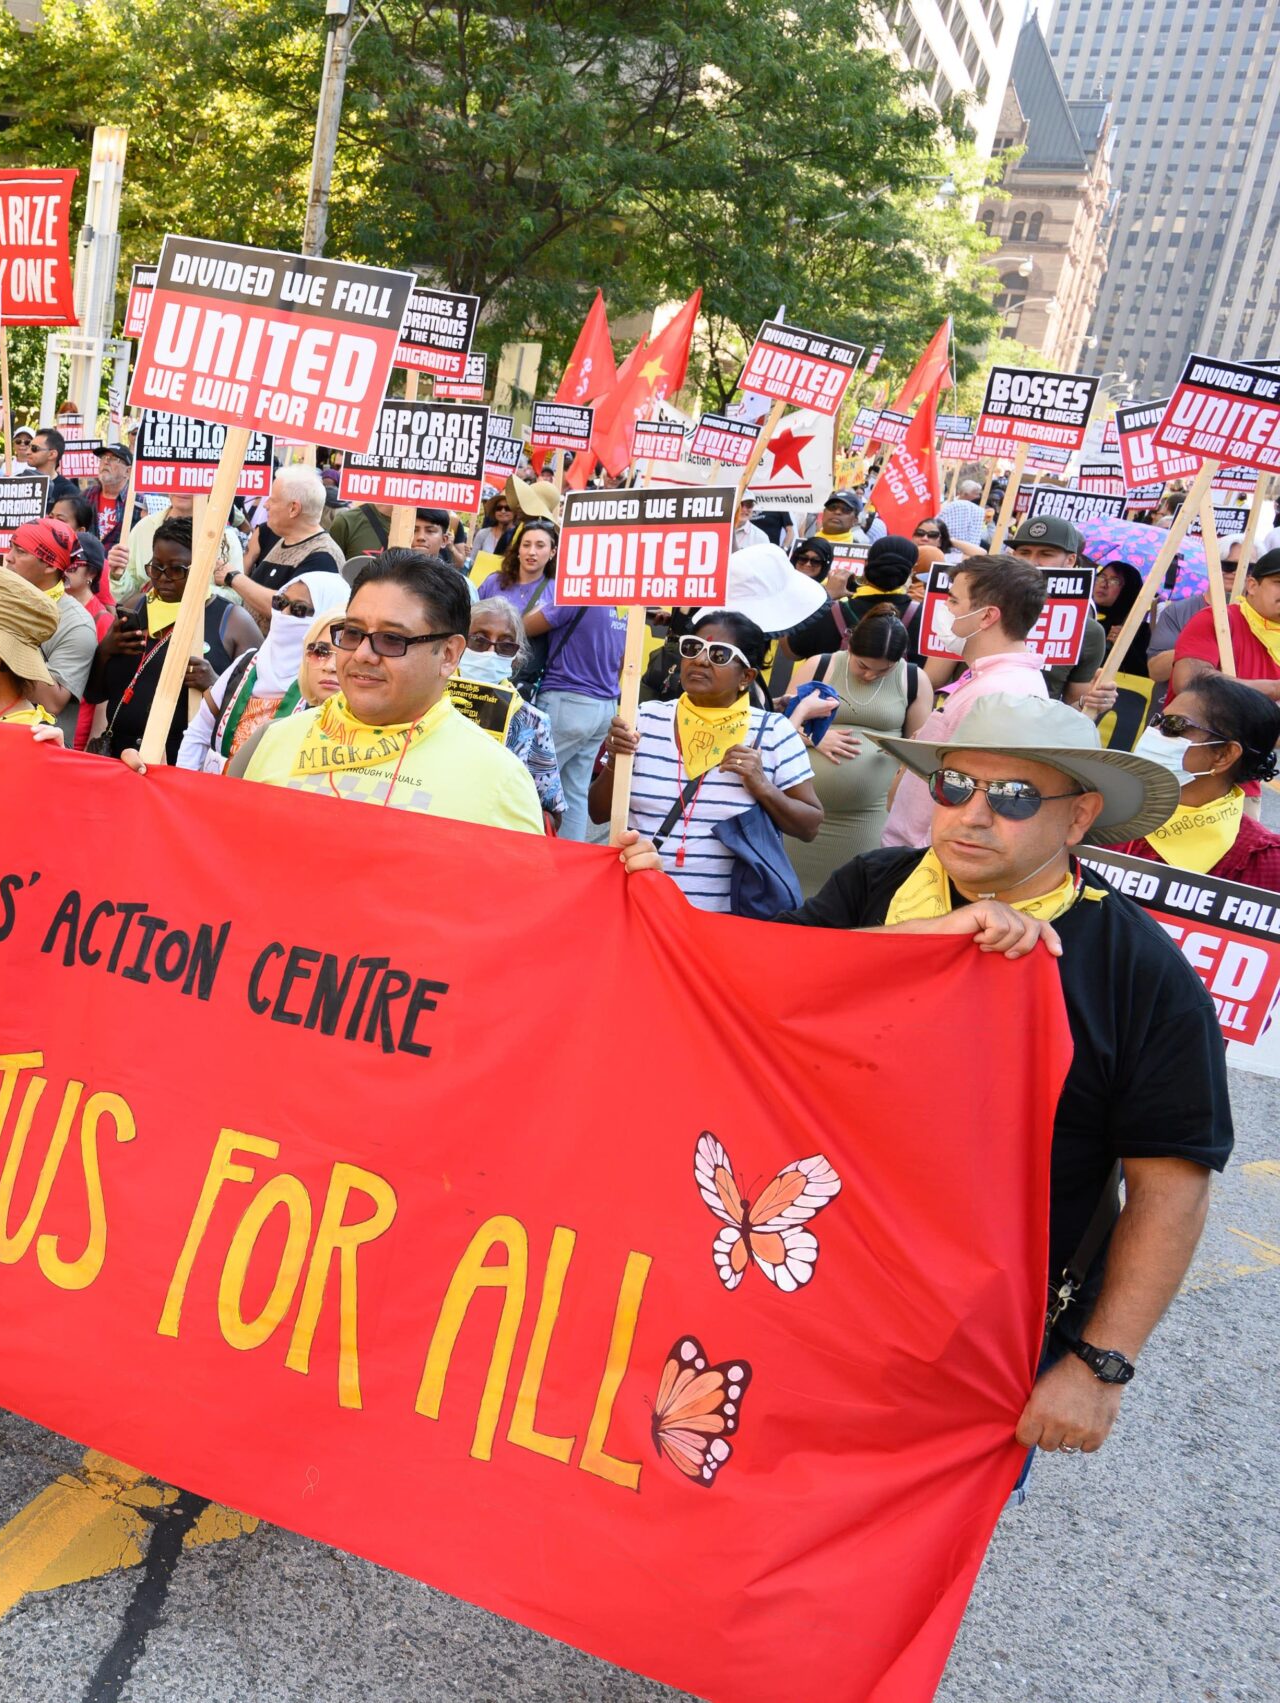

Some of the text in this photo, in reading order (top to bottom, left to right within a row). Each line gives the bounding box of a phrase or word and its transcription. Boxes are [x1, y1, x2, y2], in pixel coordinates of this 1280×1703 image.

[170, 254, 392, 319] DIVIDED WE FALL
[456, 302, 468, 318] &
[153, 302, 377, 403] UNITED
[410, 332, 427, 343] THE
[429, 335, 464, 349] PLANET
[763, 328, 856, 365] DIVIDED WE FALL
[750, 347, 846, 396] UNITED
[1190, 364, 1278, 399] DIVIDED WE
[144, 368, 187, 401] WE
[191, 377, 249, 414] WIN
[254, 389, 310, 428] FOR
[314, 402, 361, 439] ALL
[744, 373, 834, 410] WE WIN FOR ALL
[990, 372, 1092, 411] BOSSES
[987, 401, 1084, 424] CUT JOBS & WAGES
[1172, 390, 1280, 451] UNITE
[533, 434, 547, 444] NOT
[635, 434, 680, 452] UNITED
[696, 429, 752, 455] UNITED
[983, 418, 1009, 434] NOT
[1012, 421, 1079, 444] MIGRANTS
[1161, 425, 1254, 460] WE WIN FOR
[143, 446, 192, 458] CAUSE THE
[351, 454, 380, 467] CAUSE
[383, 456, 398, 468] THE
[402, 459, 447, 473] HOUSING
[451, 462, 477, 476] CRISIS
[142, 466, 175, 486] NOT
[1132, 455, 1198, 482] WE WIN
[35, 484, 42, 496] &
[348, 474, 474, 504] NOT MIGRANTS
[755, 494, 813, 504] nternational
[1037, 491, 1122, 513] CORPORATE
[570, 497, 724, 522] DIVIDED WE FALL
[566, 531, 719, 576] UNITED
[833, 546, 868, 559] WE FALL
[563, 577, 717, 598] WE WIN FOR ALL
[1047, 577, 1083, 595] FALL
[1043, 642, 1070, 658] ALL
[384, 772, 423, 787] VISUALS
[1164, 882, 1217, 916] WE
[42, 889, 232, 1000] ACTION
[248, 941, 449, 1058] CENTRE
[157, 1128, 399, 1411] FOR
[414, 1214, 652, 1492] ALL
